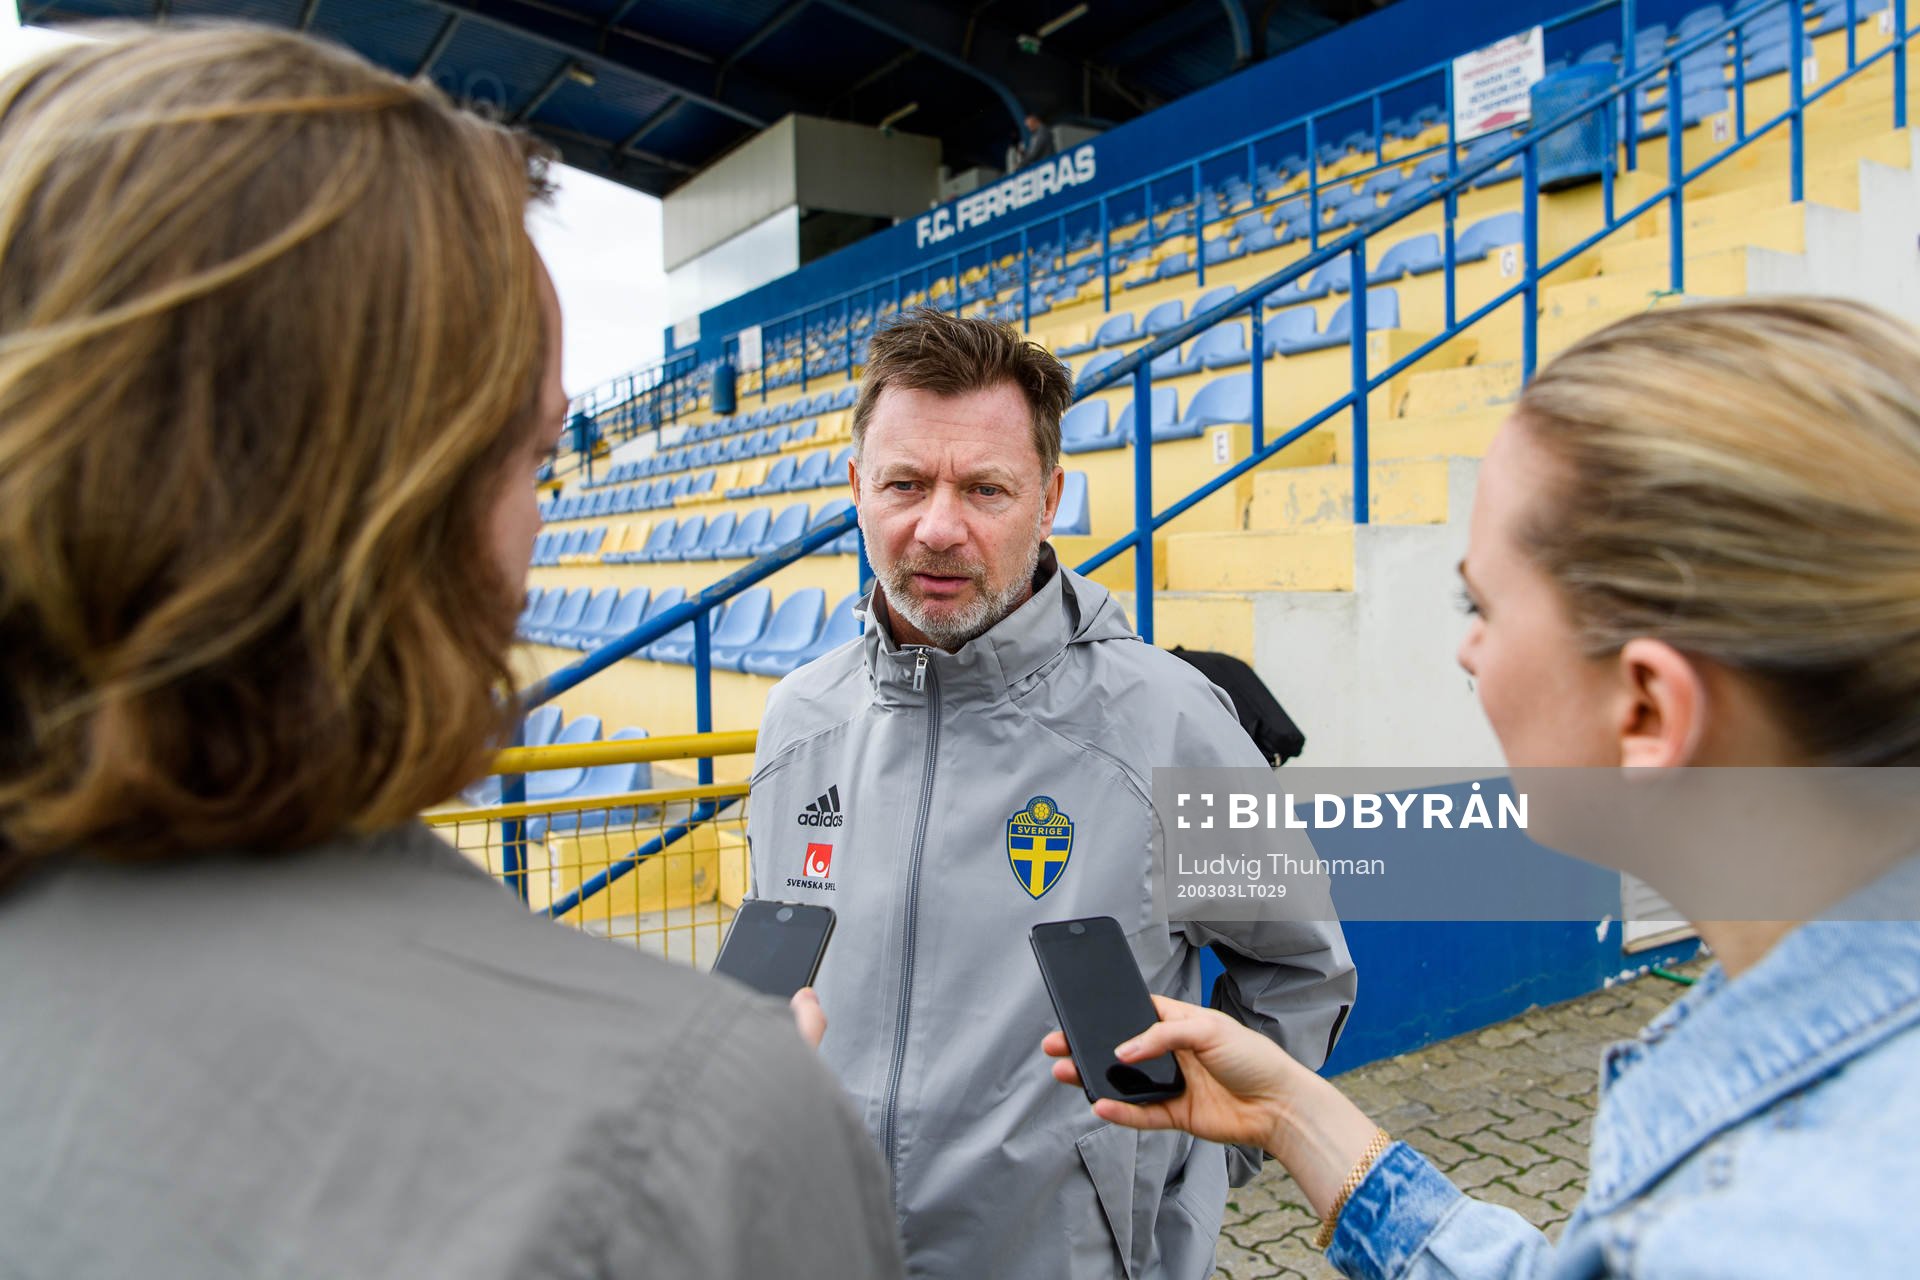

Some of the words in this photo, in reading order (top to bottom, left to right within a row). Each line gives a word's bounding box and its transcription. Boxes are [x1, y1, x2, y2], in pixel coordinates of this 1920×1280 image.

[916, 206, 955, 249] F.C.
[956, 144, 1096, 233] FERREIRAS
[1216, 433, 1226, 461] E
[797, 810, 843, 827] adidas
[1017, 826, 1063, 835] SVERIGE
[786, 878, 823, 890] SVENSKA
[824, 882, 836, 891] SPEL
